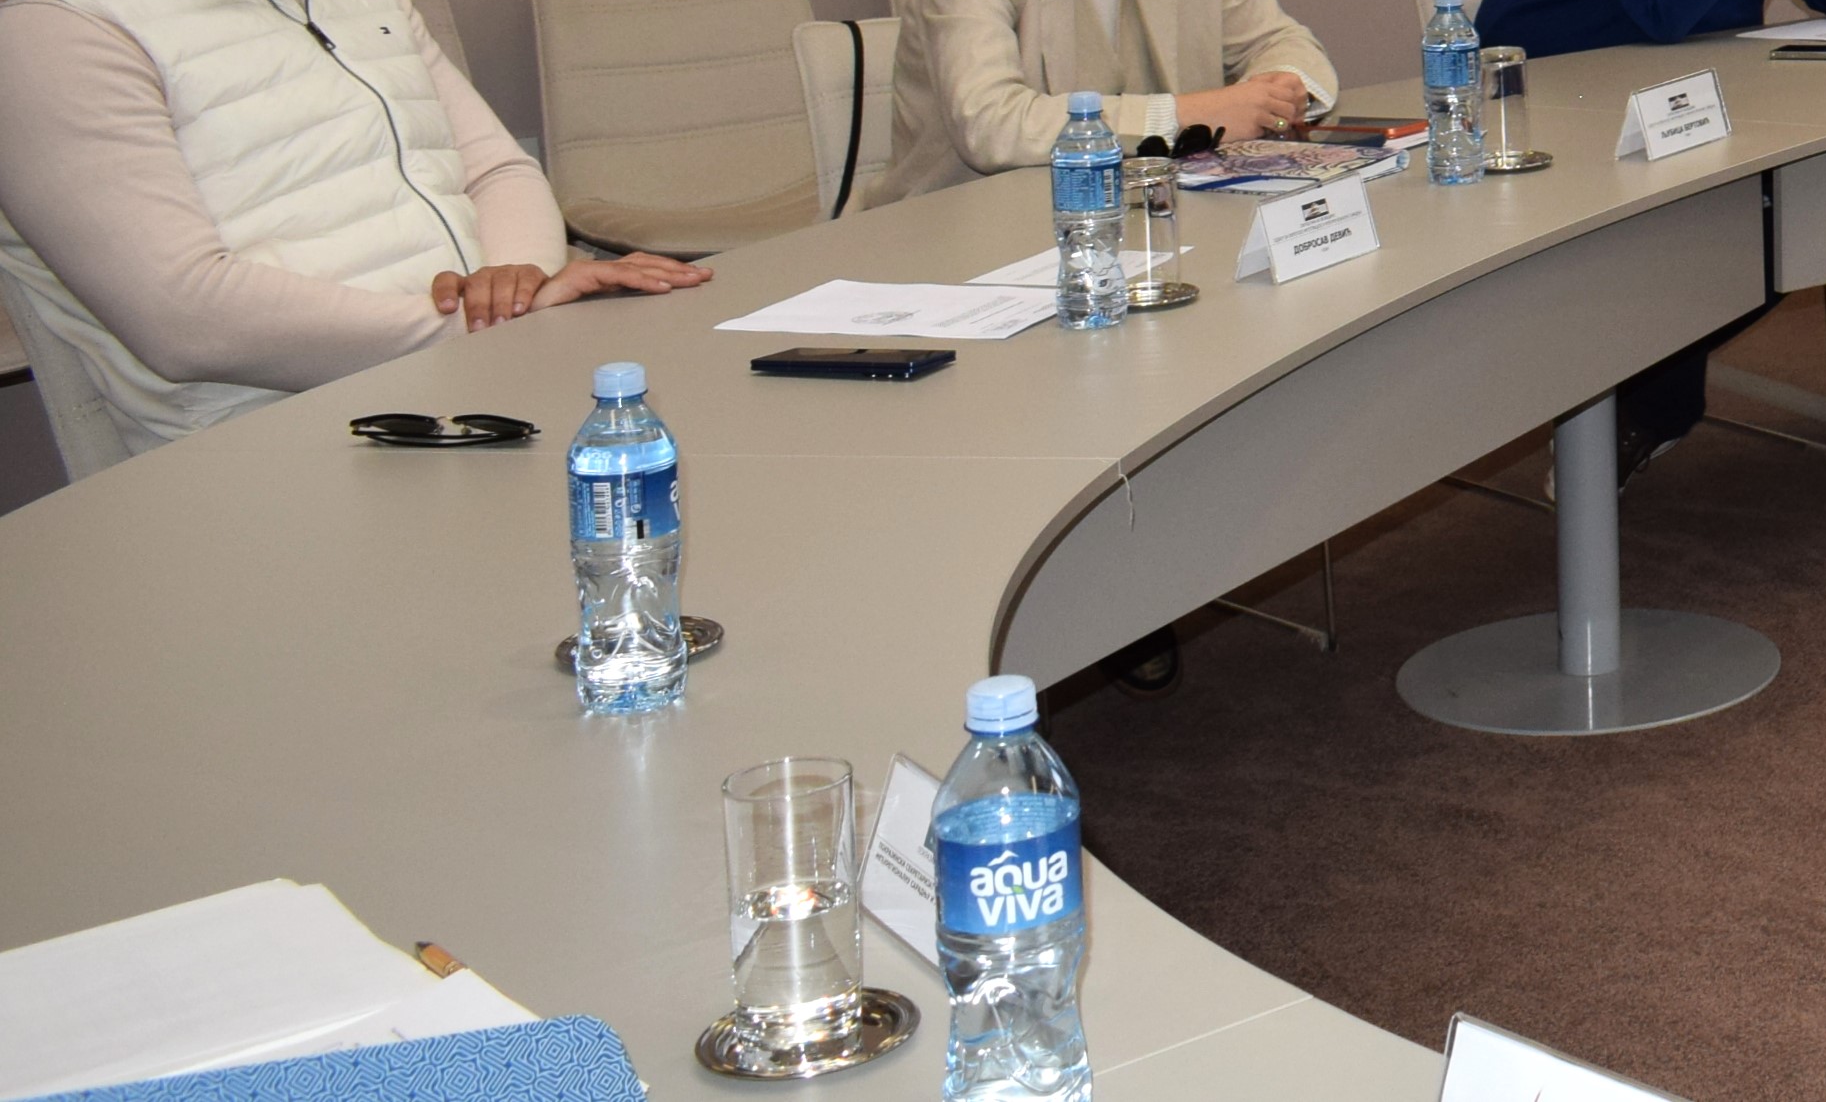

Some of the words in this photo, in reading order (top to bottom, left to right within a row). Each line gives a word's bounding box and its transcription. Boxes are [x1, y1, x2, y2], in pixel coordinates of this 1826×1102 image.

[1293, 235, 1330, 255] ДОБРОСАВ
[970, 850, 1068, 896] aqua
[977, 882, 1064, 927] viva
